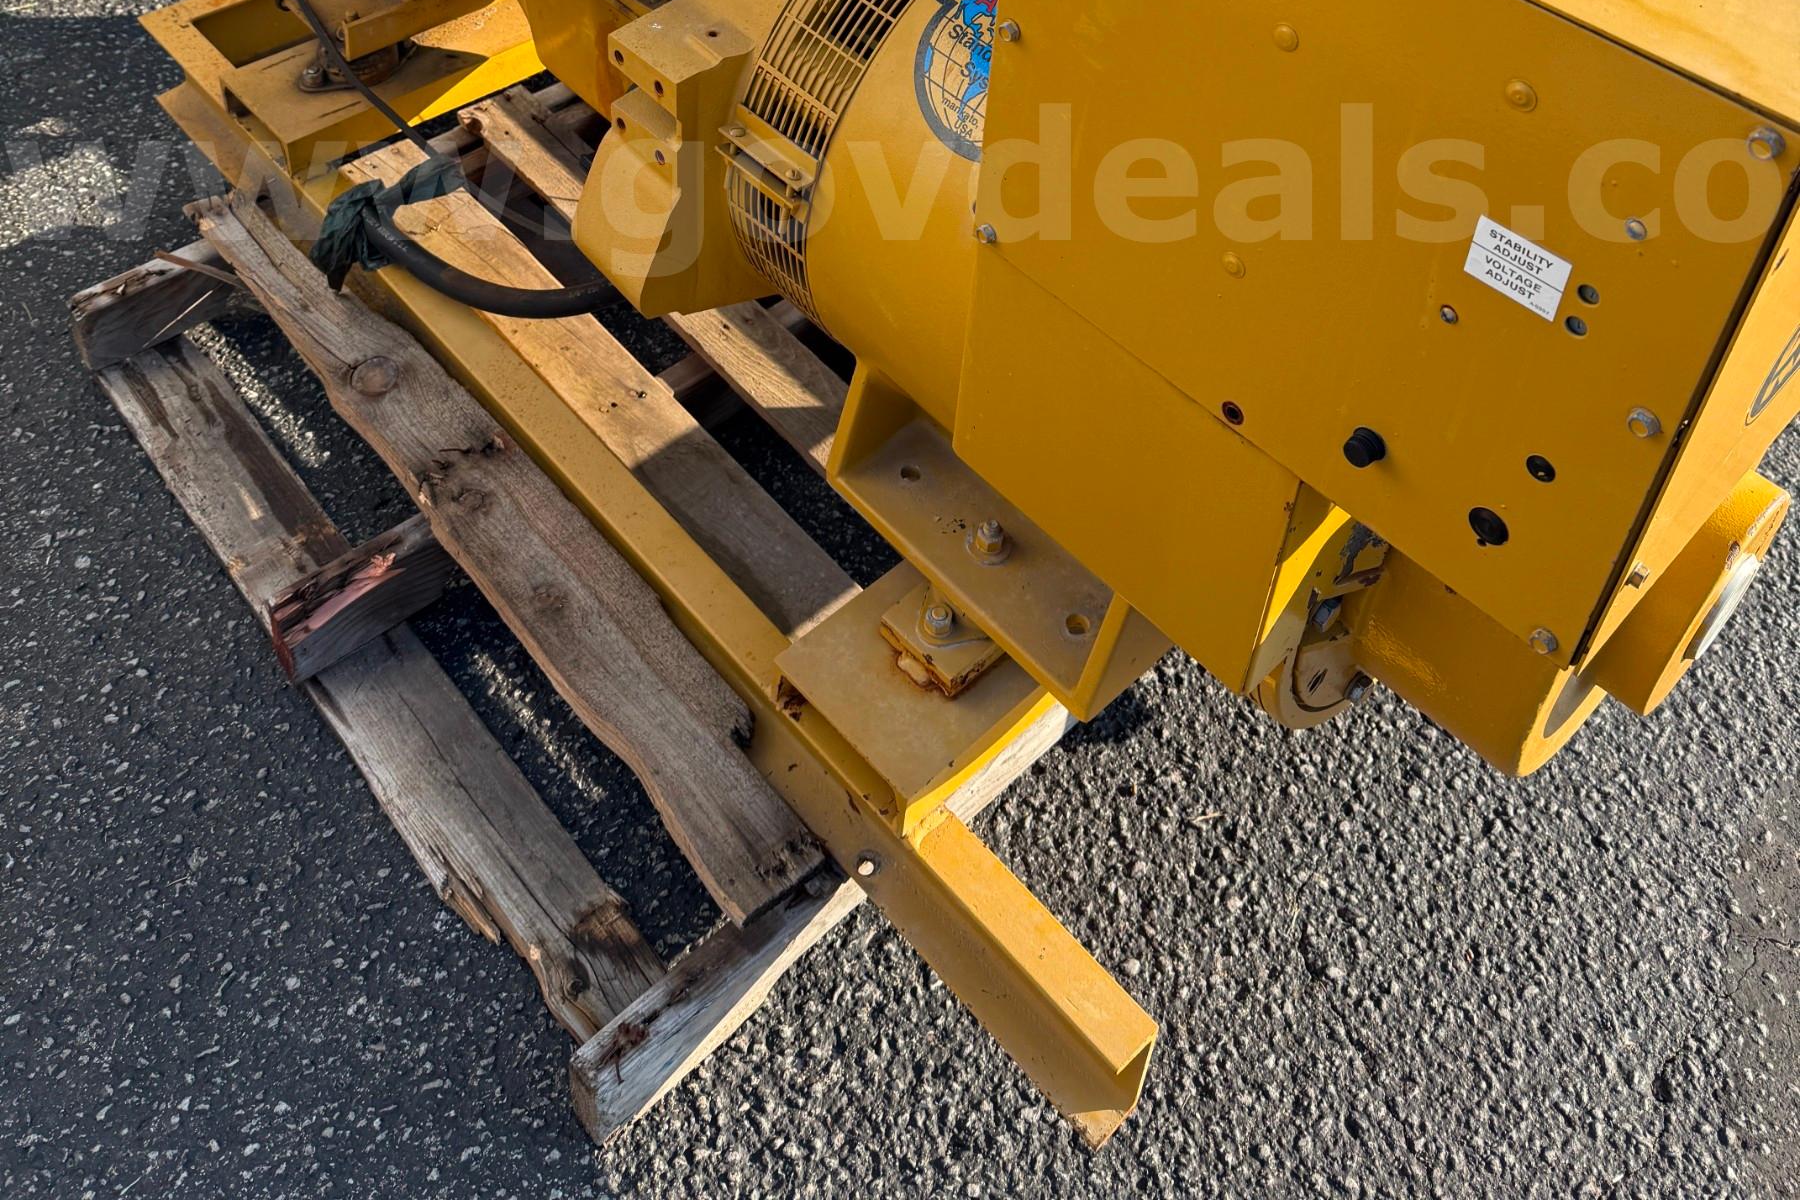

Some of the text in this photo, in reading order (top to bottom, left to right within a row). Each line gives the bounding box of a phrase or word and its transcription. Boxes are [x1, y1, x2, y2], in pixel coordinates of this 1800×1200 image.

[954, 120, 973, 139] USA
[1489, 228, 1554, 269] STABILITY
[1493, 244, 1544, 275] ADJUST
[1485, 255, 1543, 293] VOLTAGE
[1485, 269, 1535, 300] ADJUST
